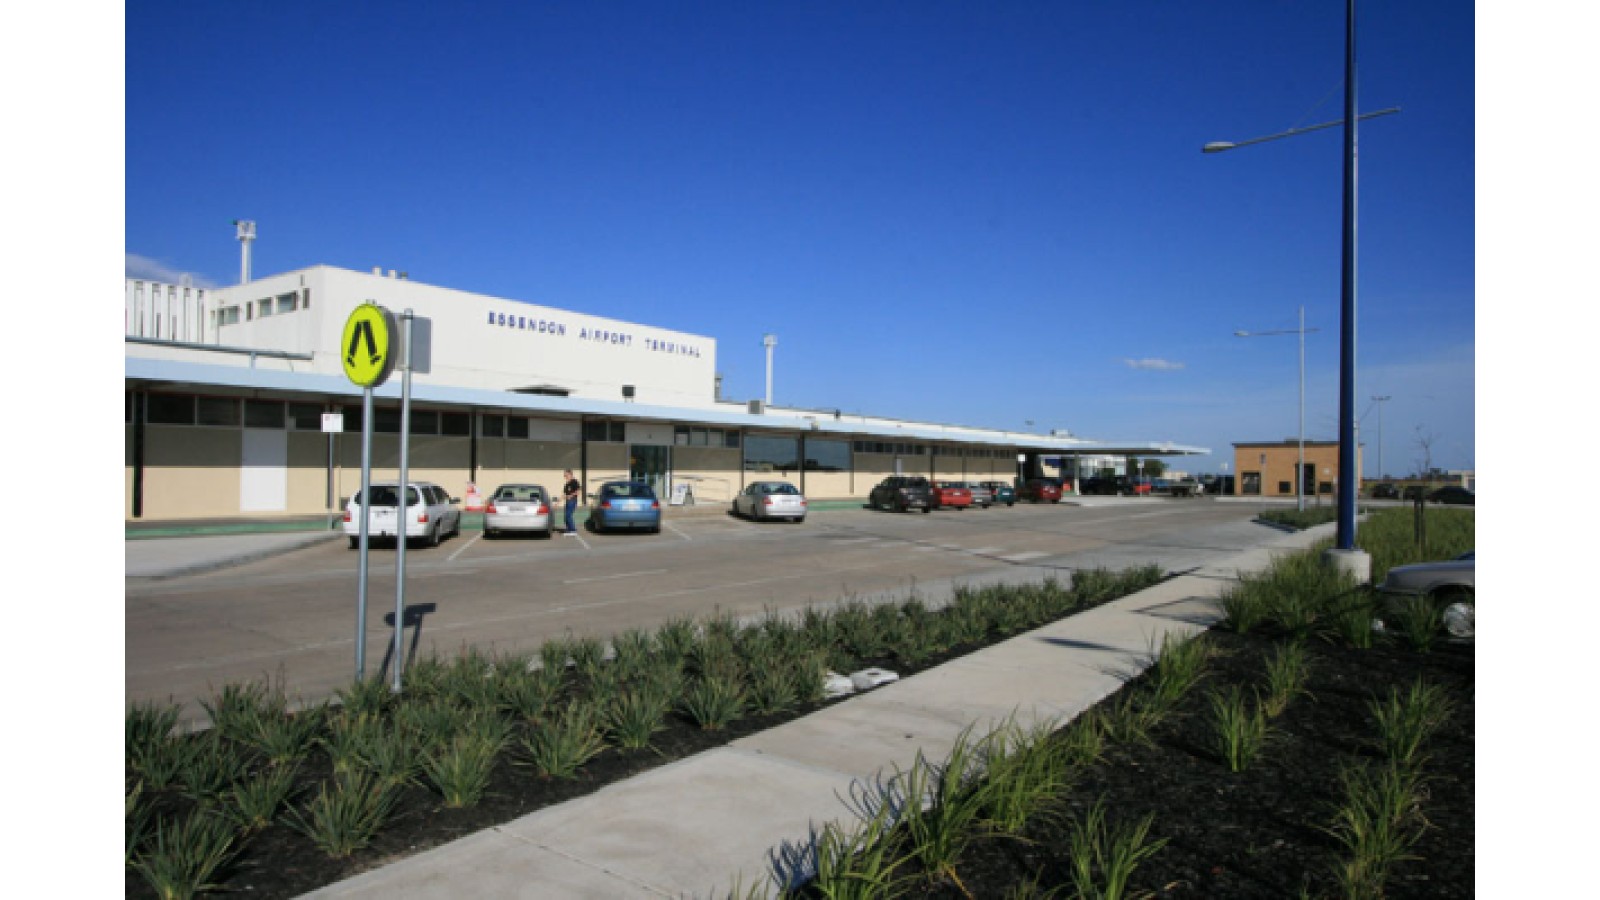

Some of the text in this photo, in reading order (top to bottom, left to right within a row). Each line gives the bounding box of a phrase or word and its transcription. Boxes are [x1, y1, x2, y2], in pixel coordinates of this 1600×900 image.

[487, 311, 701, 358] ESSENDON AIRPORT TERMINAL
